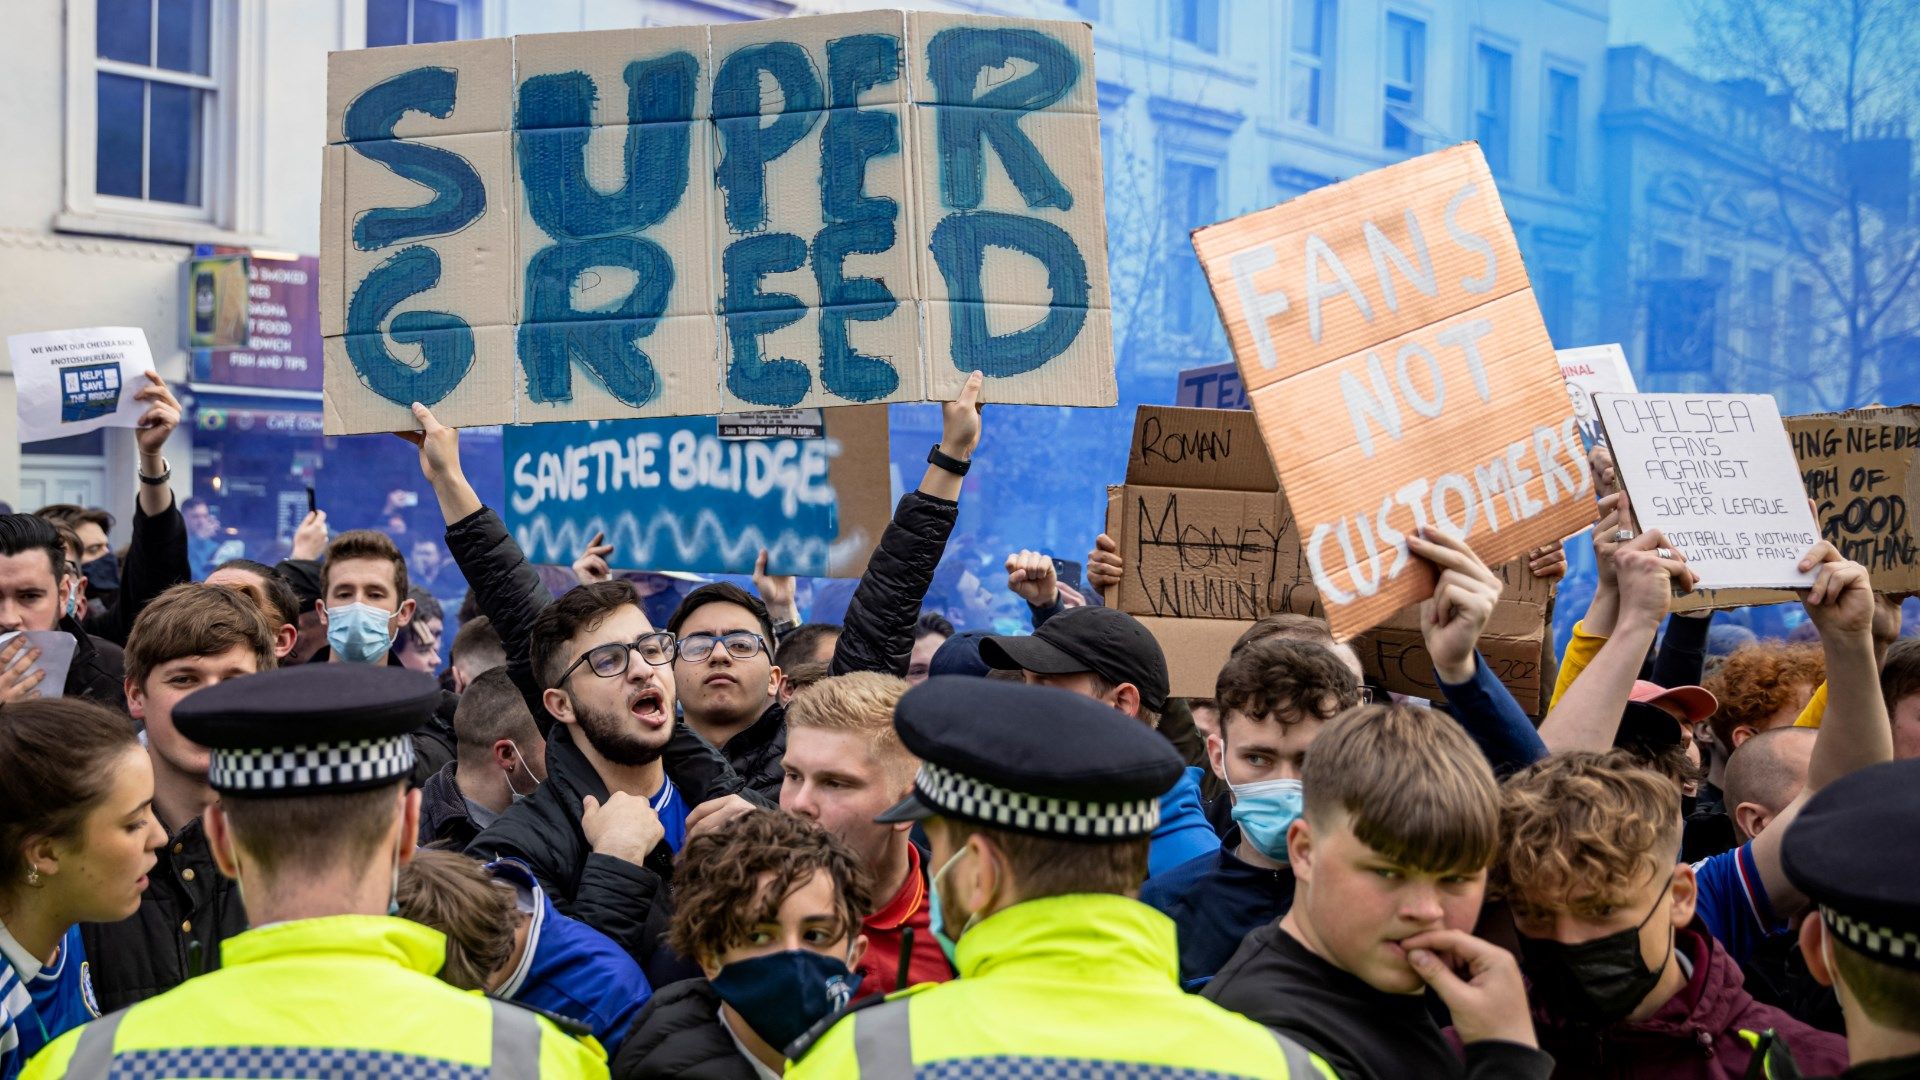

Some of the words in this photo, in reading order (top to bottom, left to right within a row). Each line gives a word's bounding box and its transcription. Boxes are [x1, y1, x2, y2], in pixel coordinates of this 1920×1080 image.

[343, 27, 1080, 251] SUPER
[1231, 183, 1497, 370] FANS
[346, 211, 1091, 408] GREED
[45, 344, 68, 353] WANT
[70, 342, 85, 350] OUR
[86, 340, 116, 349] CHELSEA
[70, 393, 87, 403] THE
[88, 390, 116, 401] BRIDGE
[81, 381, 105, 391] SAVE
[1340, 319, 1493, 458] NOT
[1613, 399, 1755, 433] CHELSEA
[1141, 416, 1231, 465] ROMAN
[1652, 437, 1722, 457] FANS
[668, 429, 843, 518] BRIDGE
[1645, 460, 1749, 480] AGAINST
[1849, 466, 1890, 492] OF
[1673, 481, 1713, 496] THE
[1306, 414, 1589, 605] CUSTOMERS
[1652, 496, 1717, 516] SUPER
[1721, 497, 1789, 515] LEAGUE
[1818, 494, 1906, 541] GOOD
[1138, 493, 1292, 577] MONEY
[1667, 531, 1731, 547] OOTBALL
[1736, 532, 1751, 546] IS
[1755, 532, 1814, 545] NOTHING
[1686, 547, 1748, 562] WITHOUT
